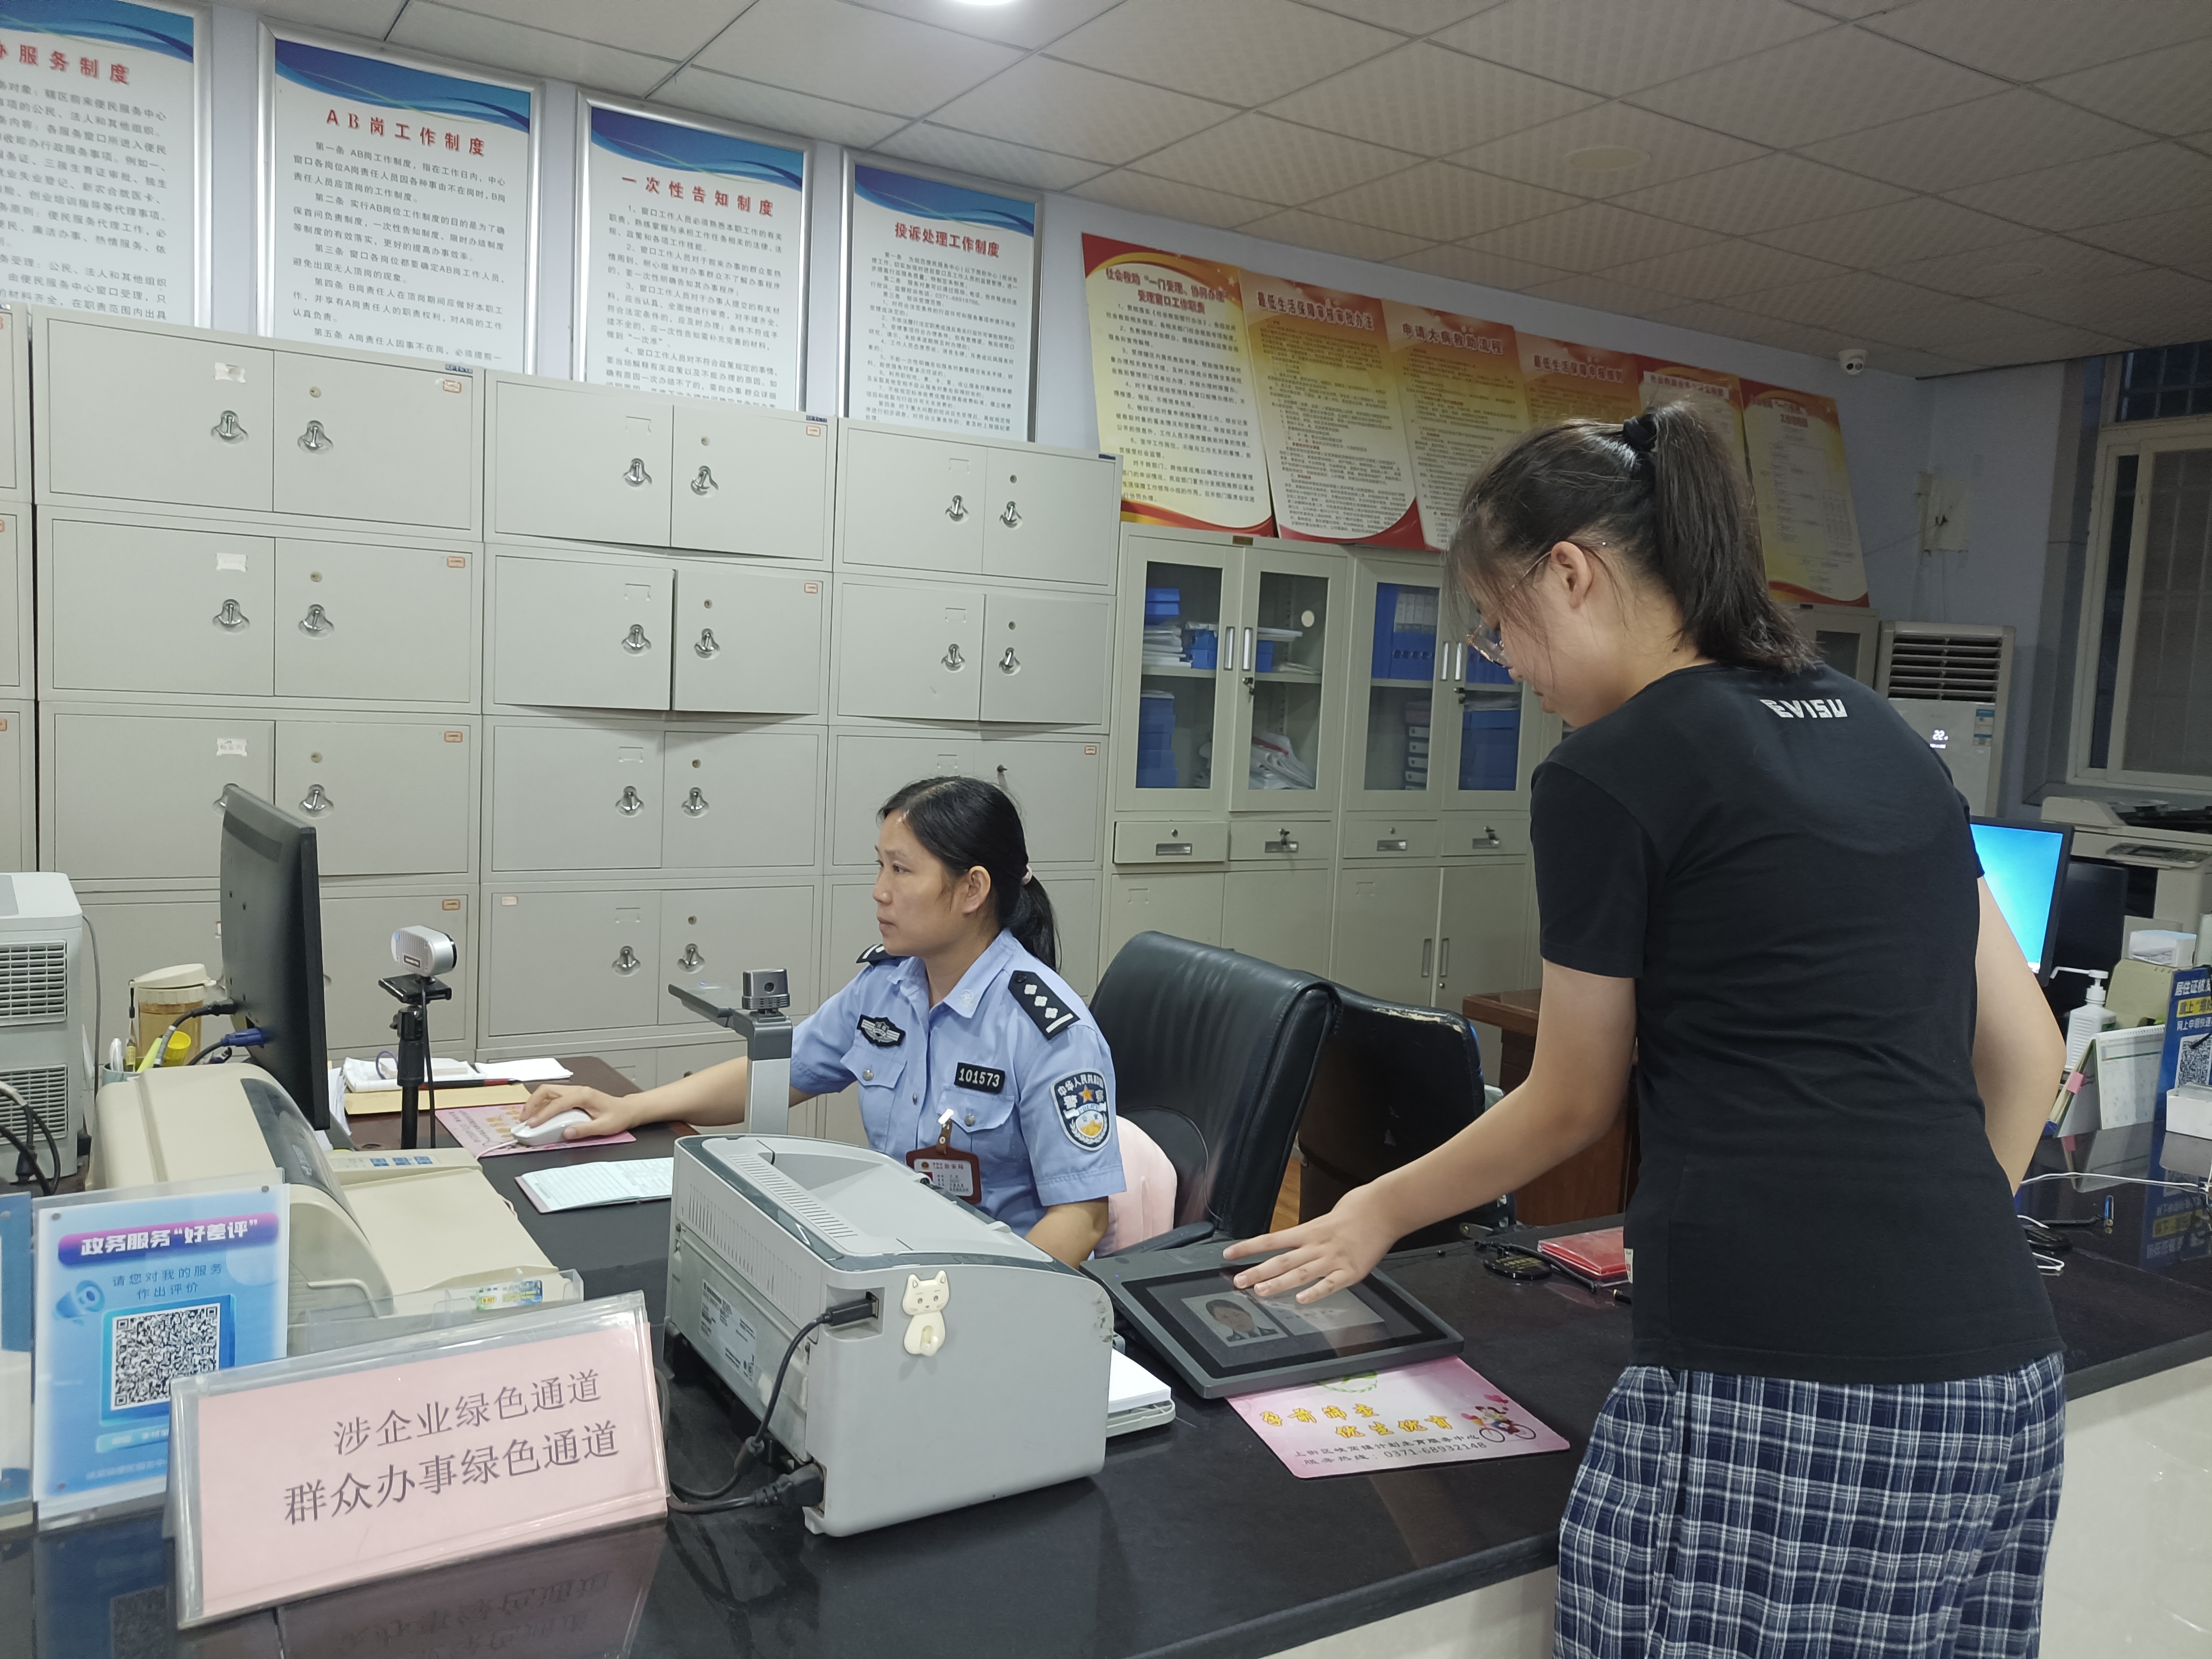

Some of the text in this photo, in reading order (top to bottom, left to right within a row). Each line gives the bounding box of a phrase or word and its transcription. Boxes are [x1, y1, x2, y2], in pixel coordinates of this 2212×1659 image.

[326, 109, 485, 156] AB岗工作制度
[622, 176, 773, 217] 一次性告知制度
[895, 222, 999, 258] 投诉处理工作制度
[1758, 699, 1848, 718] EVISU
[958, 1068, 1000, 1088] 101573
[81, 1219, 258, 1256] 政务服务“好差评”
[112, 1263, 222, 1287] 请您对我的服务
[138, 1282, 199, 1300] 作出评价
[333, 1369, 602, 1455] 涉企业绿色通道
[1335, 1415, 1453, 1438] 优生优育
[284, 1420, 620, 1527] 群众办事绿色通道
